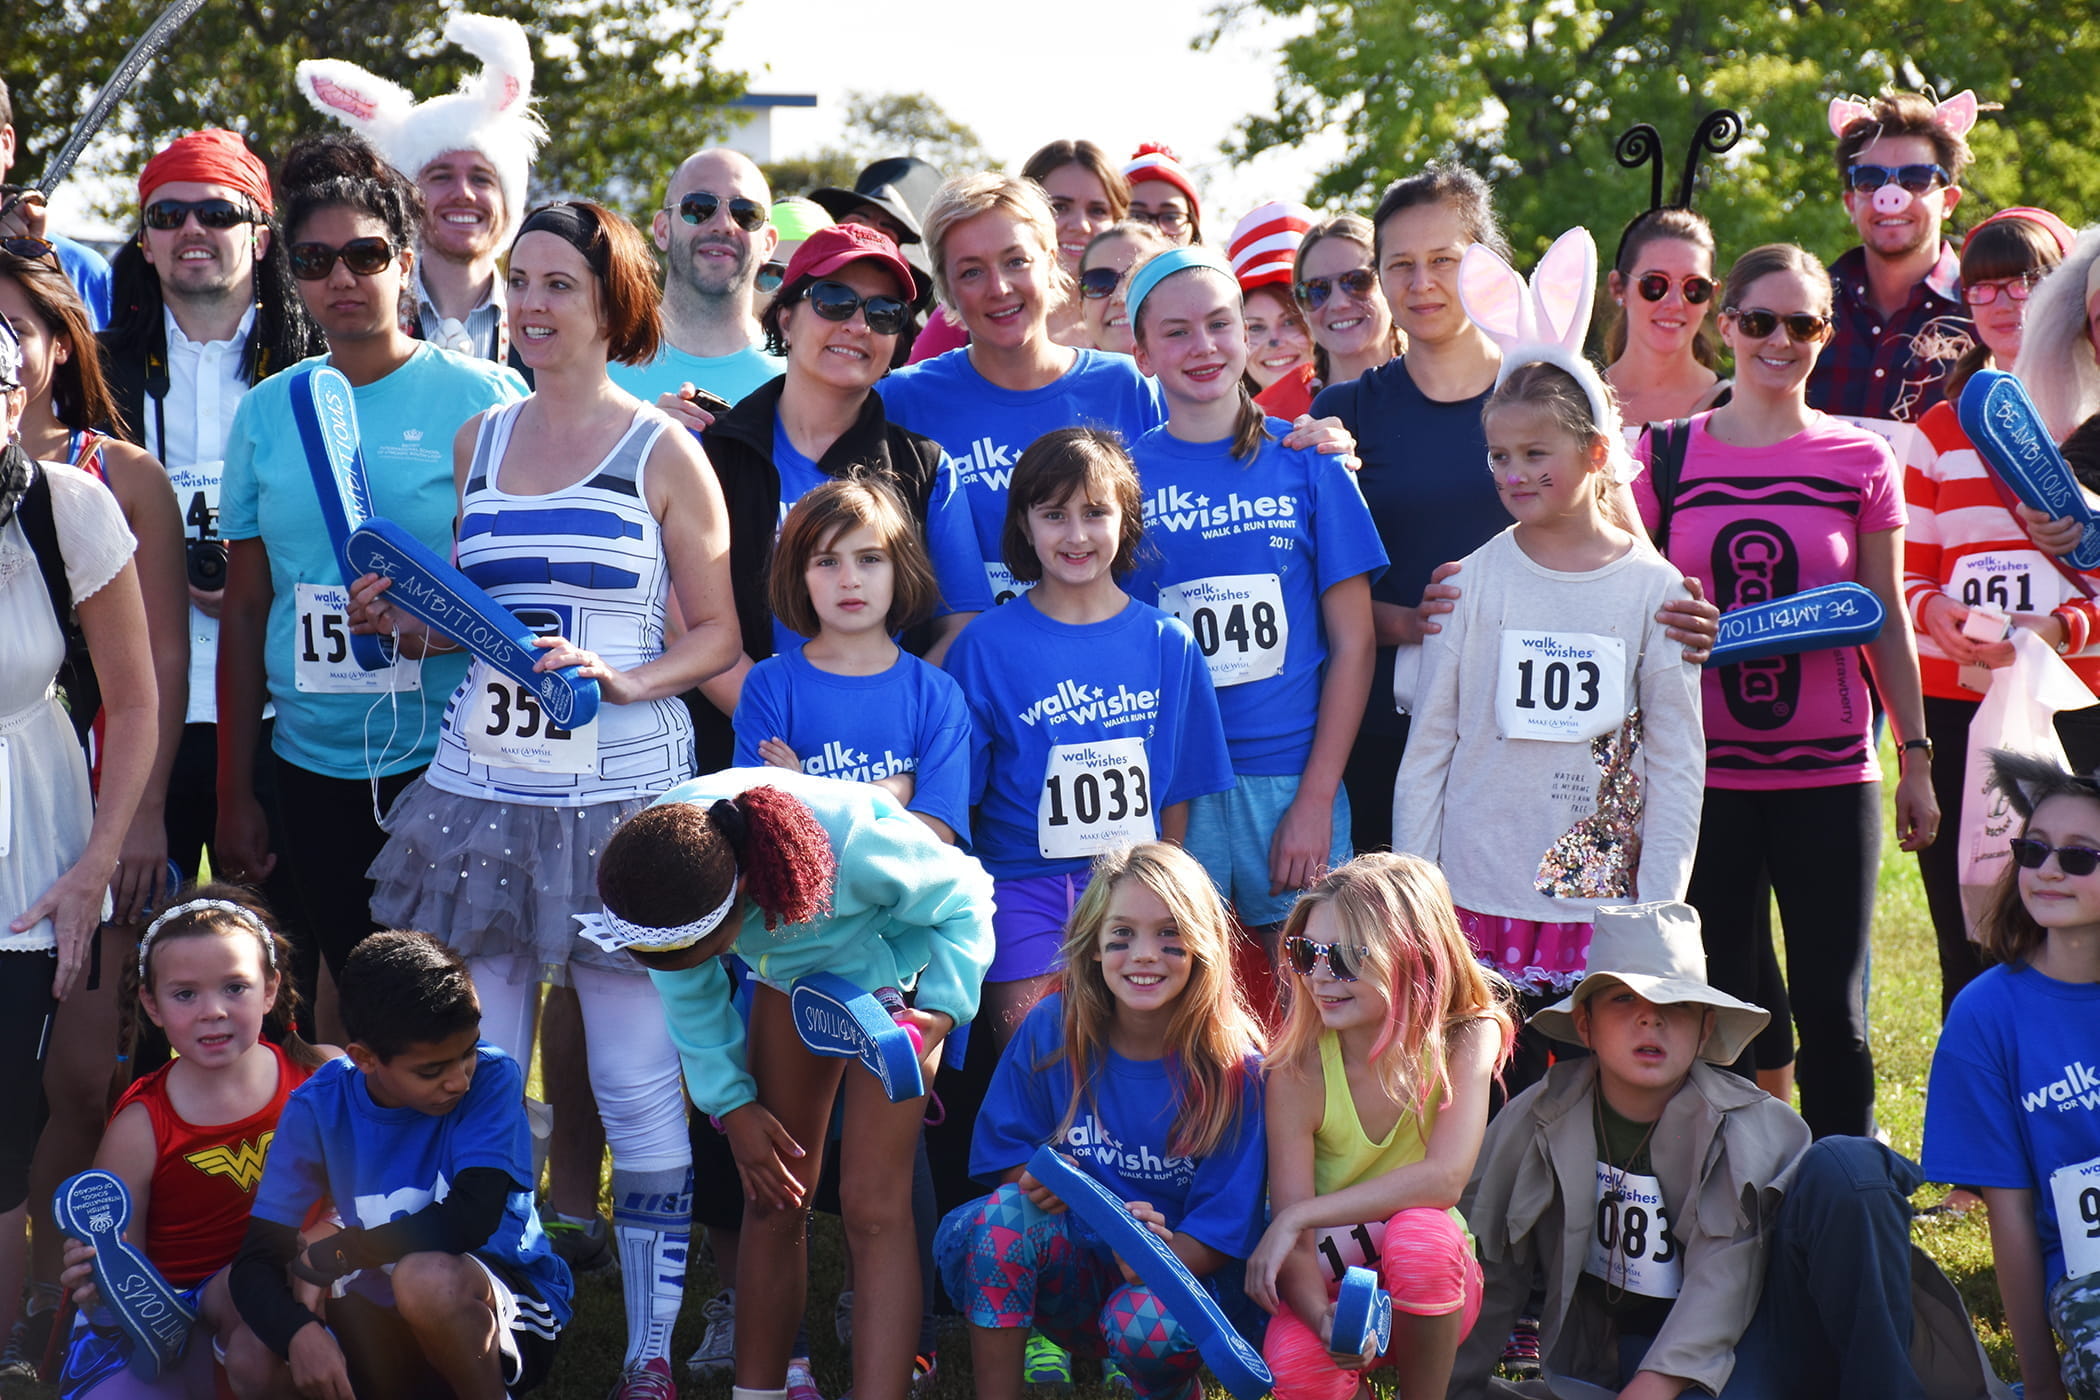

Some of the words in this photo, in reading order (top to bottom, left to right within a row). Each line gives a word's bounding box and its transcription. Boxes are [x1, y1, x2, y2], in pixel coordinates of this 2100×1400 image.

[1995, 400, 2021, 429] BE
[2010, 423, 2073, 510] AMBITIOUS
[1141, 485, 1195, 521] alk
[1159, 492, 1296, 533] wishes
[1201, 526, 1231, 540] WALK
[1233, 525, 1242, 534] &
[1243, 520, 1266, 532] RUN
[1267, 519, 1297, 529] EVENT
[1269, 535, 1295, 550] 2015
[1967, 556, 1995, 568] walk
[1986, 561, 2029, 572] wishes
[314, 591, 342, 603] walk
[1182, 583, 1214, 599] walk
[1203, 589, 1250, 603] wishes
[1963, 573, 2034, 611] 961
[398, 575, 514, 663] AMBITIOUS
[1174, 601, 1279, 657] 048
[1522, 637, 1557, 649] walk
[1544, 646, 1594, 658] wishes
[1516, 659, 1600, 712] 103
[1018, 678, 1094, 727] walk
[1050, 713, 1068, 726] FOR
[800, 740, 858, 775] alk
[1062, 748, 1097, 762] walk
[1085, 754, 1128, 769] wishes
[1046, 765, 1149, 827] 1033
[2021, 1061, 2100, 1113] walk
[2058, 1098, 2079, 1113] FOR
[1072, 1147, 1092, 1157] FOR
[1118, 1169, 1143, 1180] WALK
[1153, 1170, 1173, 1181] RUN
